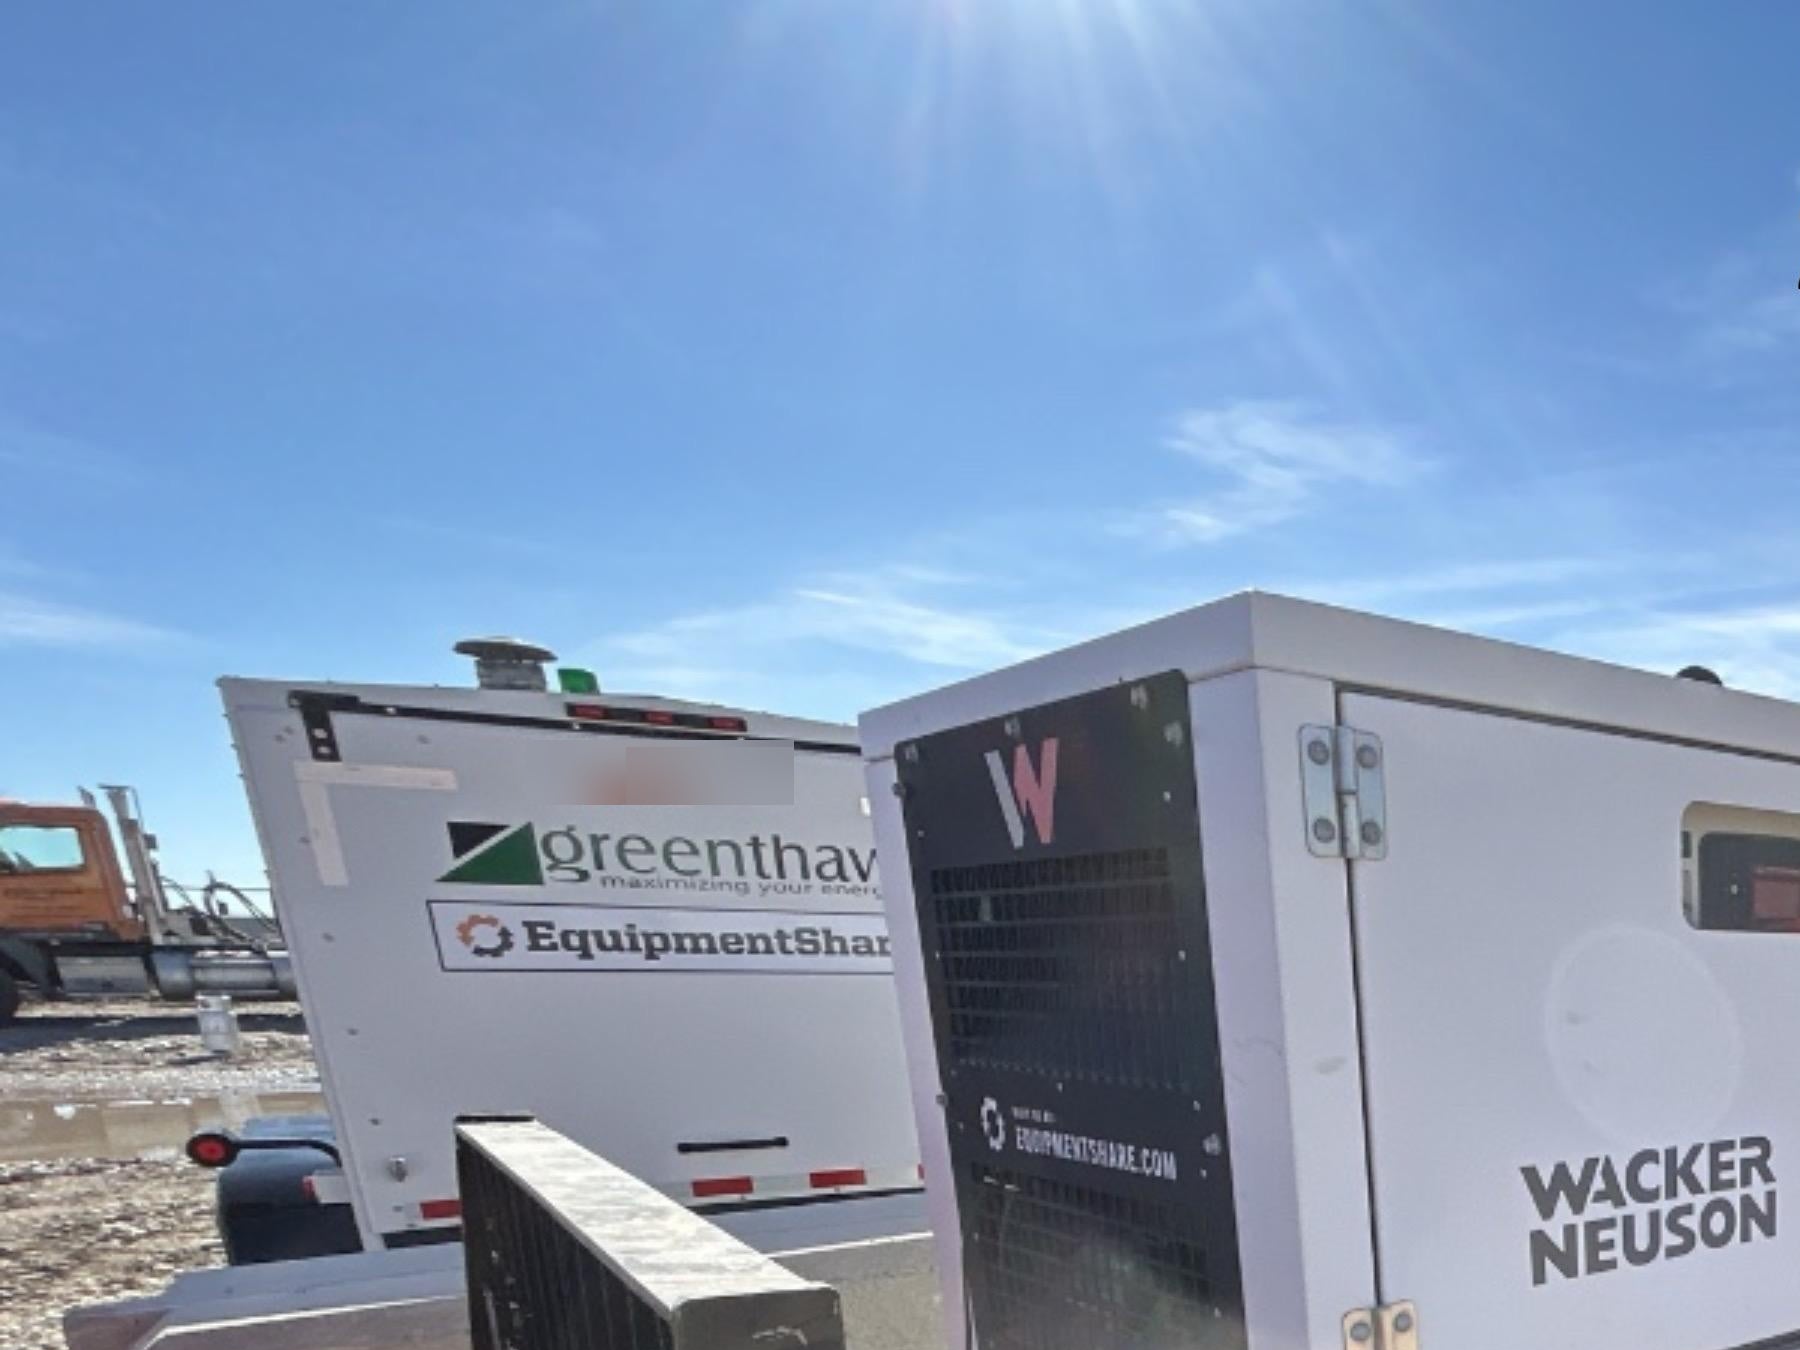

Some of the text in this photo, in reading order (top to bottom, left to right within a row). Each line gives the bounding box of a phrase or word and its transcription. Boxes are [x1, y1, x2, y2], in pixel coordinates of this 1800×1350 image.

[601, 875, 750, 897] maximizing
[758, 881, 813, 897] your
[1015, 1125, 1178, 1181] EQUIPMENTSHARE.COM
[1519, 1135, 1777, 1221] WACKER
[1529, 1189, 1777, 1288] NEUSON
